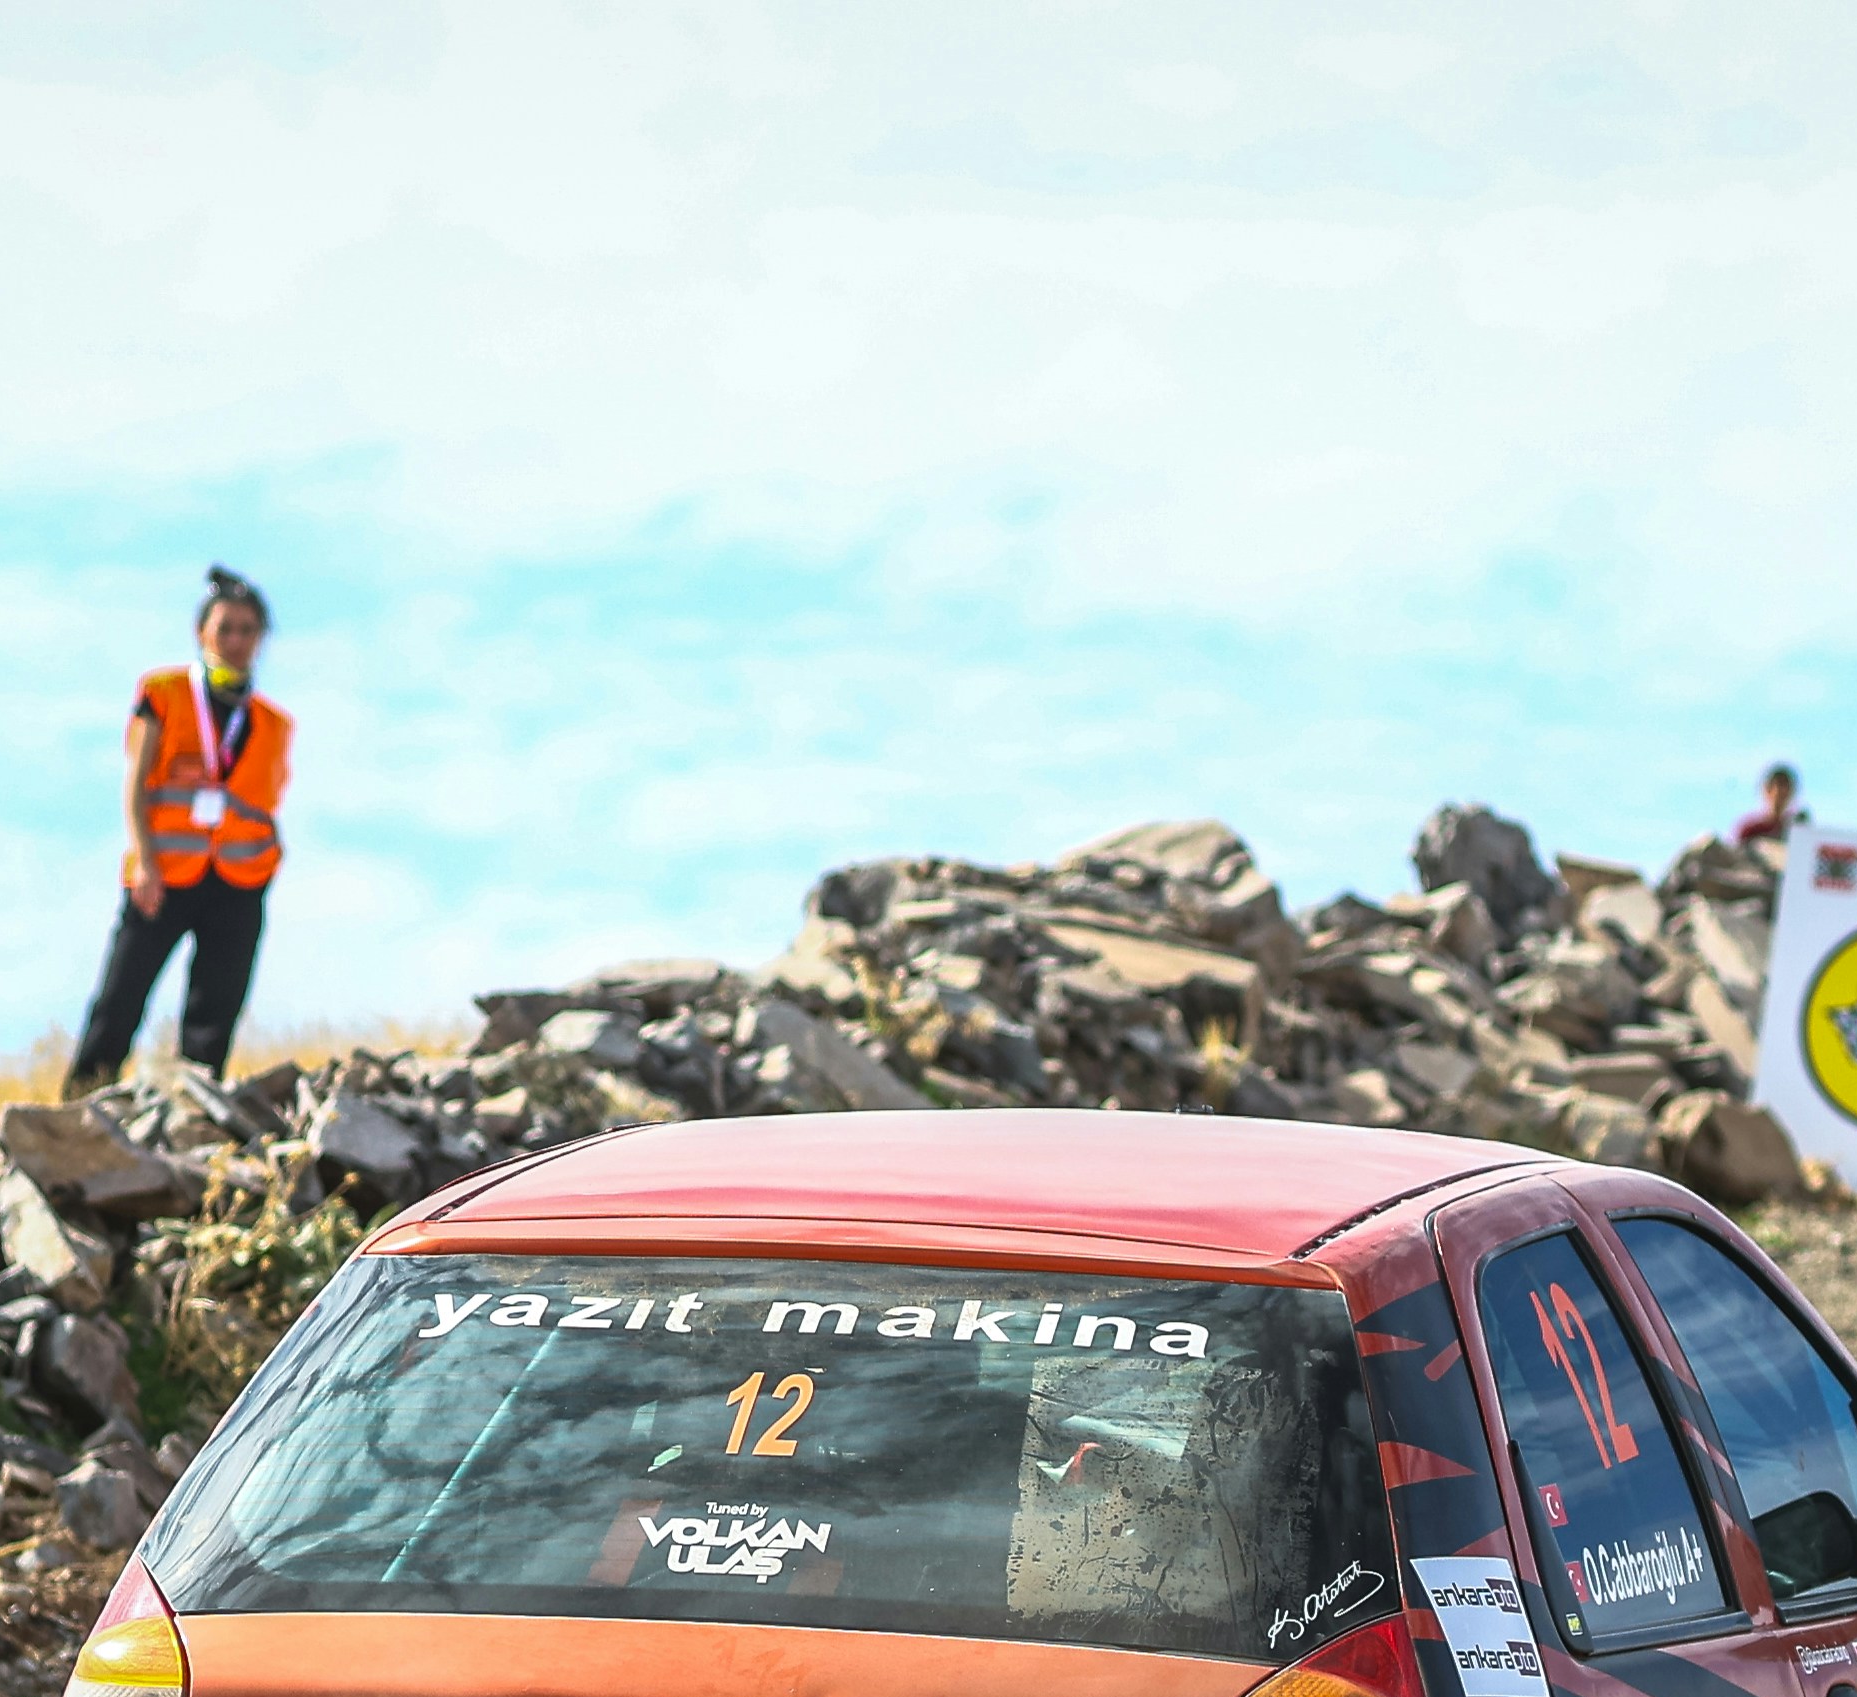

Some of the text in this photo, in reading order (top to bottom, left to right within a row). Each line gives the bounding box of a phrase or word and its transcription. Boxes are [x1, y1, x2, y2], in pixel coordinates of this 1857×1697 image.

[418, 1292, 1211, 1359] yazıt makina
[1529, 1282, 1640, 1470] 12
[725, 1371, 814, 1457] 12
[637, 1516, 832, 1554] VOLKAN
[706, 1501, 769, 1518] Tuned by
[667, 1543, 789, 1584] ULAŞ
[1680, 1527, 1704, 1583] A+
